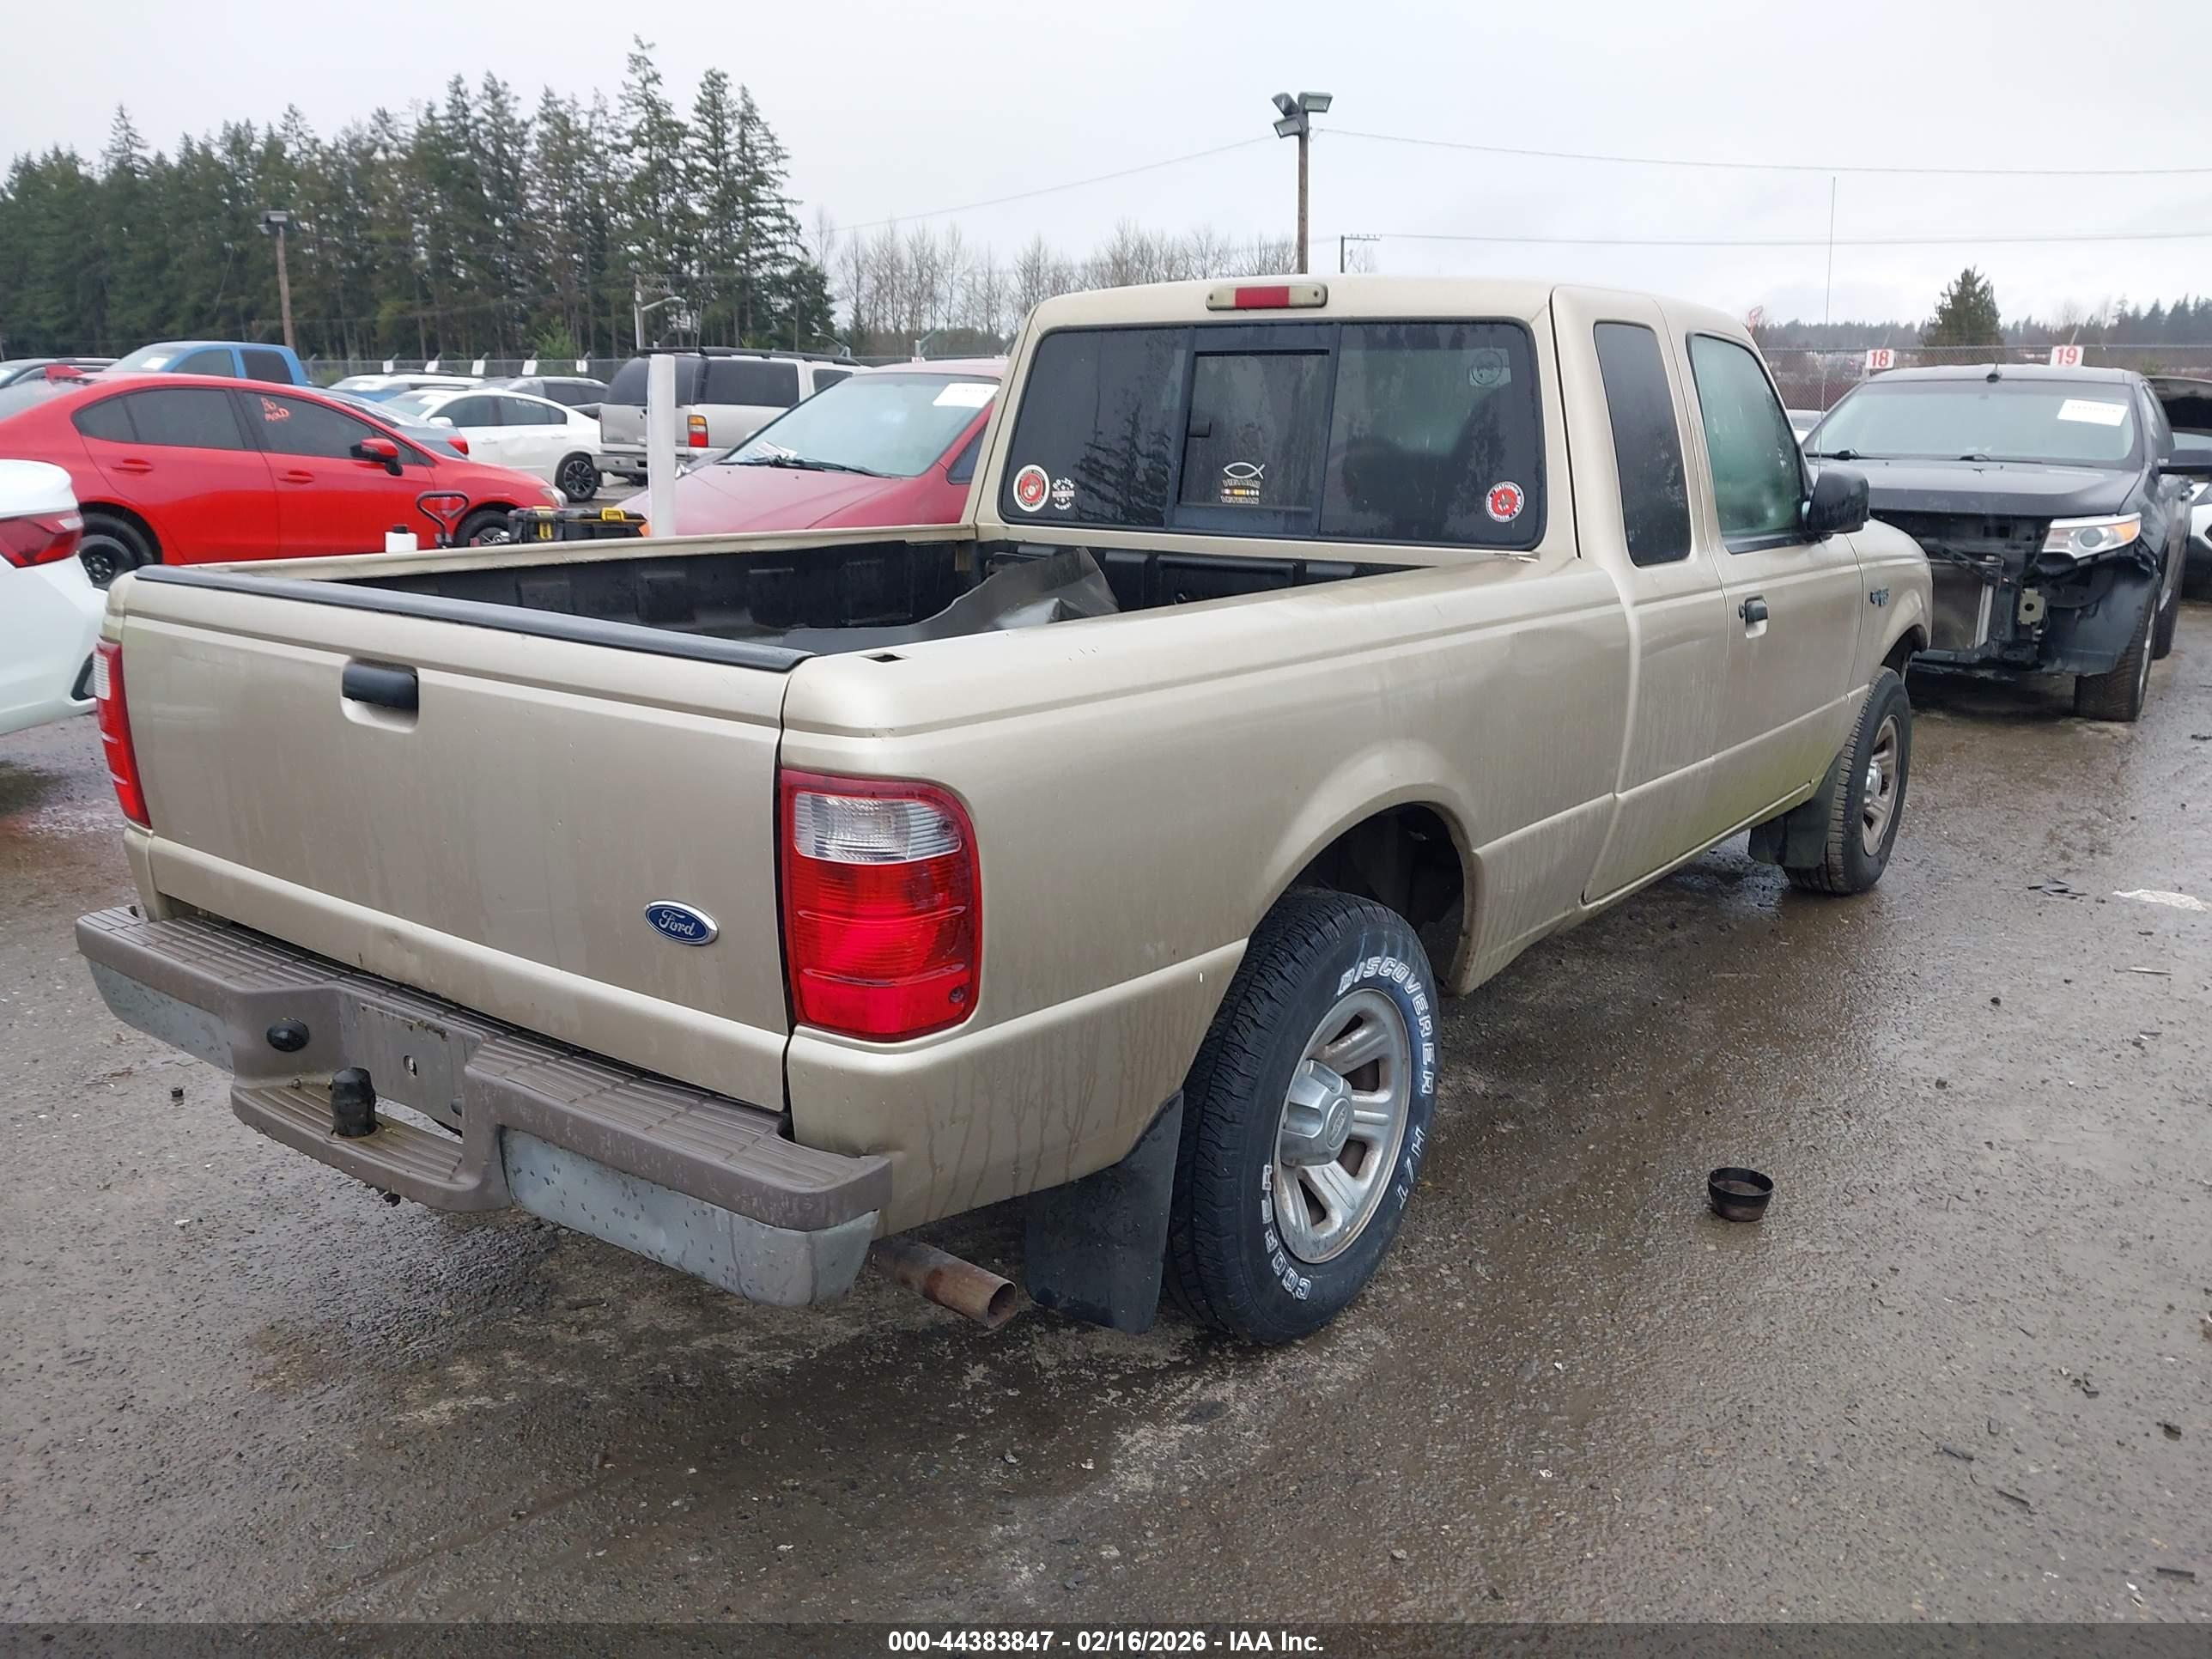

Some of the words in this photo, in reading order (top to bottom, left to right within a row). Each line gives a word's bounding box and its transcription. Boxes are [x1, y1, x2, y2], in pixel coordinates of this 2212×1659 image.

[1871, 350, 1890, 368] 18
[2057, 346, 2077, 365] 19
[658, 909, 696, 937] Ford
[1336, 956, 1436, 1095] DISCOVERER
[1261, 1164, 1312, 1300] COOPER
